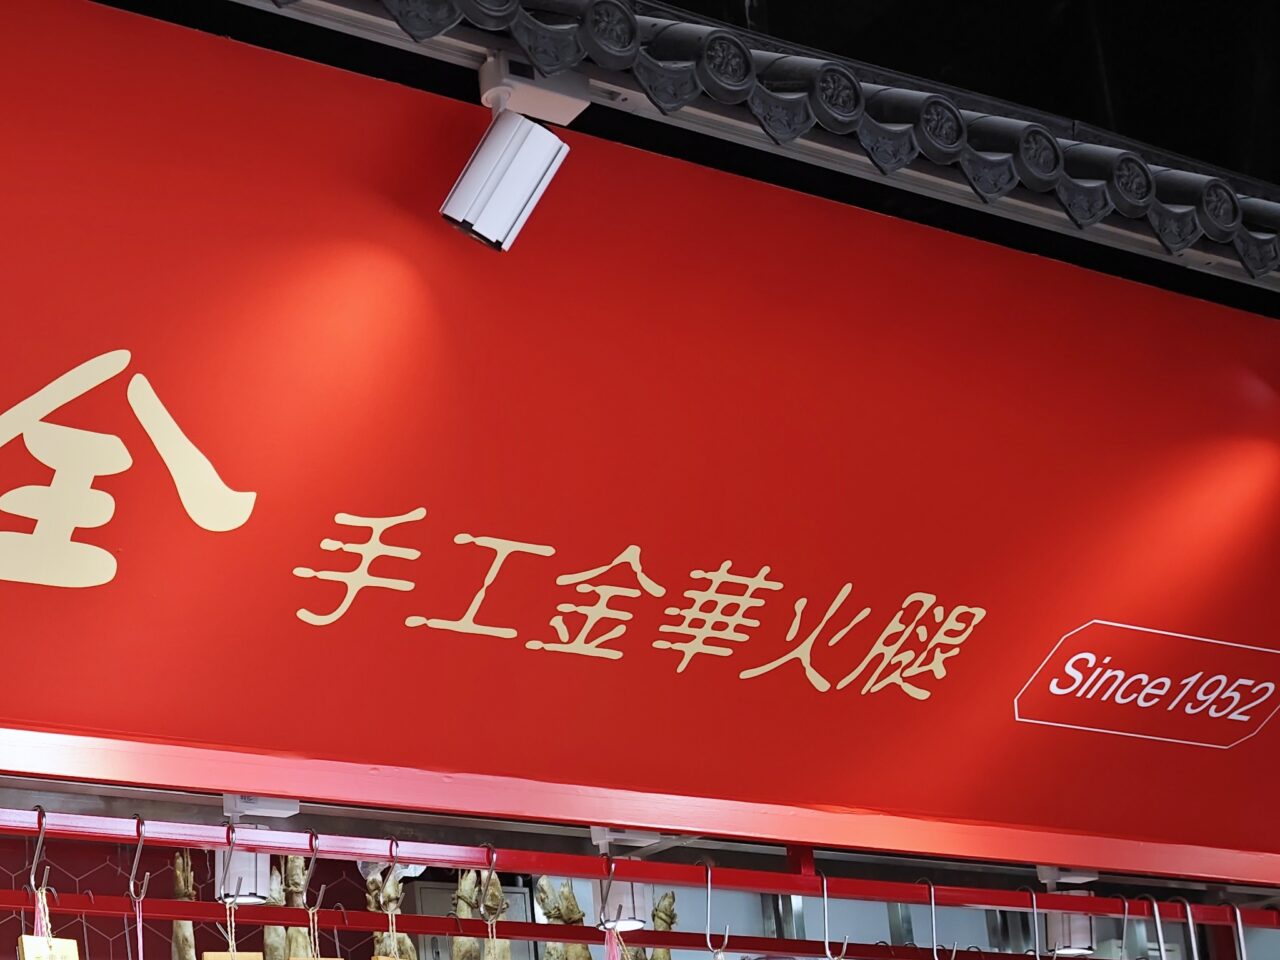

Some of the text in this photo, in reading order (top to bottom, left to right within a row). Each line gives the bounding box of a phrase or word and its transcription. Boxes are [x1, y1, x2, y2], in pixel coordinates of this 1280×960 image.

[292, 507, 987, 700] 手工金華火腿
